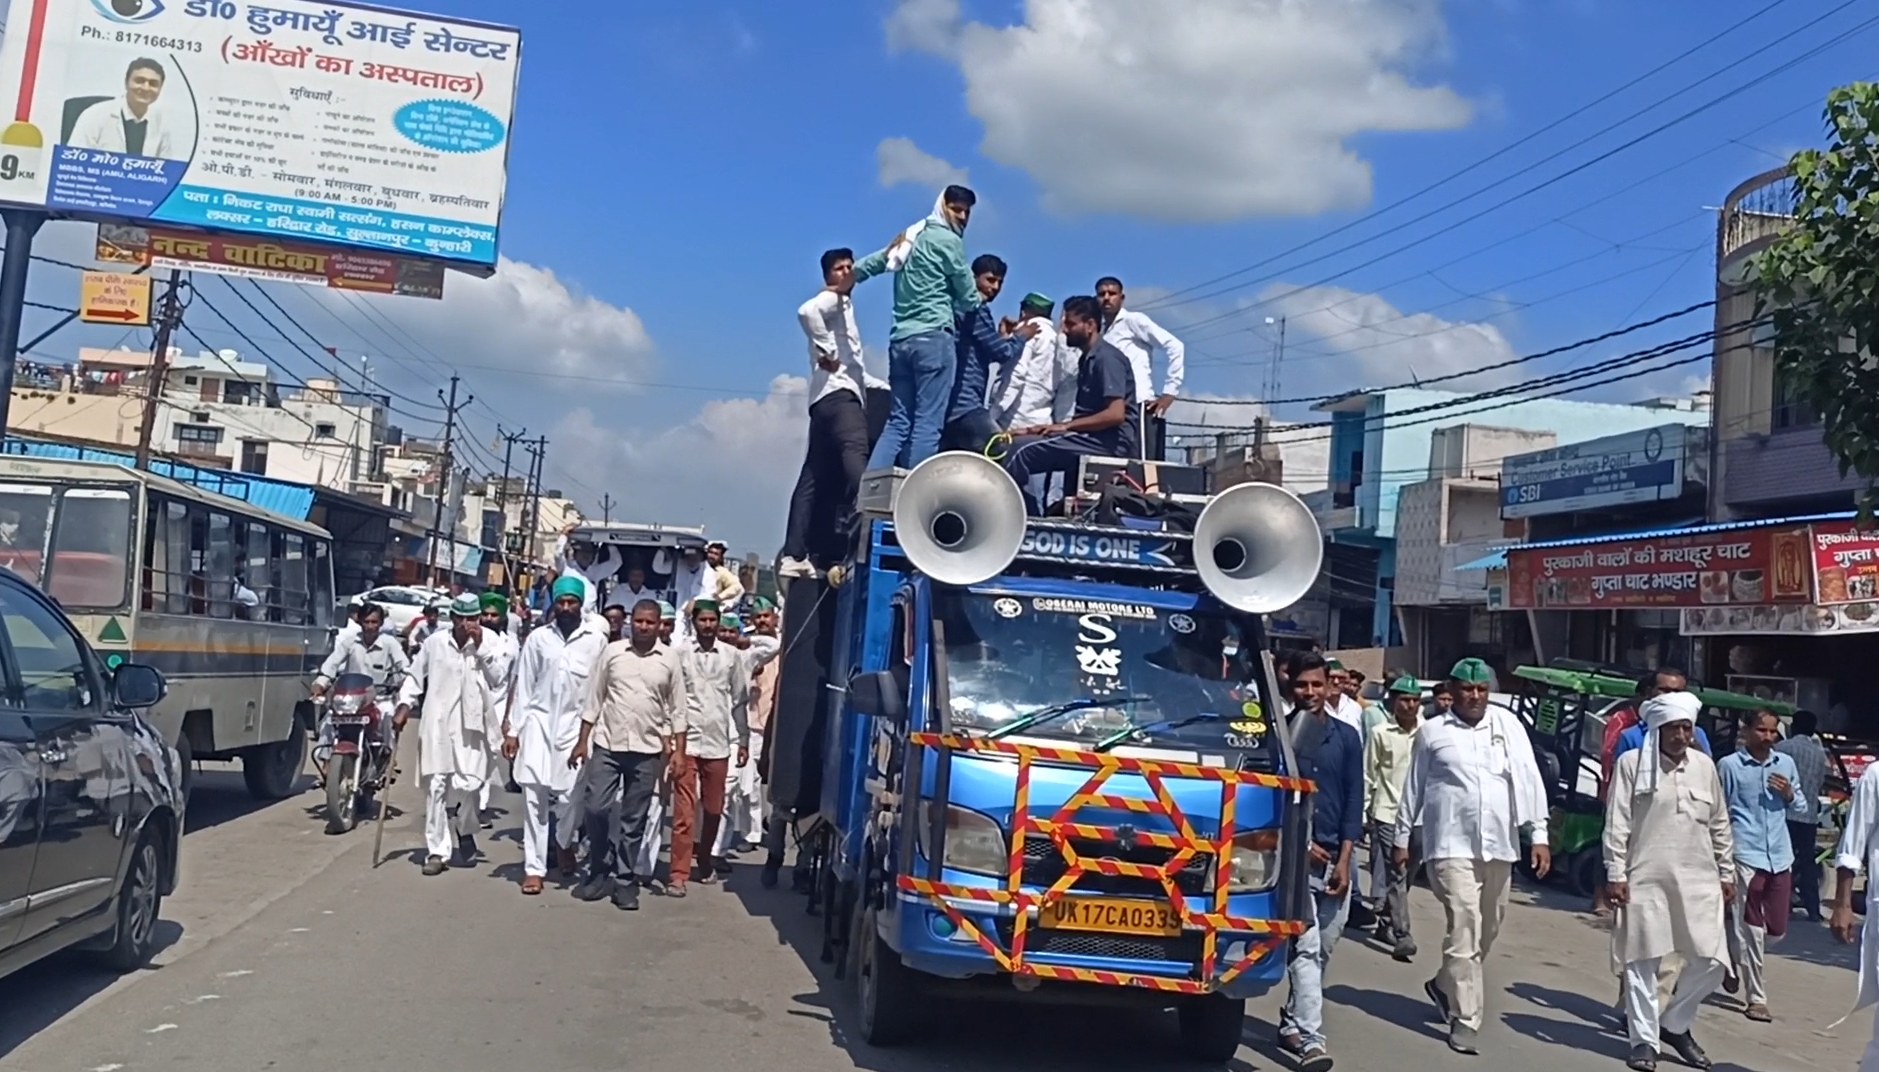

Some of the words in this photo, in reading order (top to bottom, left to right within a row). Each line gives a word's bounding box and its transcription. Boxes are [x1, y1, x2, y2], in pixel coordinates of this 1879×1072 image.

[115, 31, 203, 53] 8171664313
[247, 5, 344, 46] हुमायूँ
[346, 22, 416, 49] आई
[423, 28, 511, 60] सेन्टर
[315, 54, 353, 75] का
[359, 62, 484, 100] अस्पताल)
[18, 170, 35, 180] KM
[324, 192, 342, 202] AM
[151, 236, 212, 259] नन्द
[222, 243, 329, 273] वाटिका
[1511, 464, 1559, 485] Customer
[1560, 459, 1599, 477] Service
[1602, 452, 1632, 471] Point
[1519, 484, 1541, 503] SBI
[1020, 531, 1065, 555] GOD
[1069, 535, 1091, 556] IS
[1095, 537, 1140, 560] ONE
[1543, 550, 1594, 576] पुरकाजी
[1597, 547, 1632, 566] वालों
[1633, 544, 1656, 564] की
[1660, 545, 1714, 568] मशहूर
[1716, 542, 1751, 559] चाट
[1833, 549, 1872, 568] गुप्ता
[1592, 574, 1622, 599] गुप्ता
[1625, 573, 1650, 590] चाट
[1651, 571, 1698, 590] भण्डार
[1087, 601, 1133, 614] MOTORS
